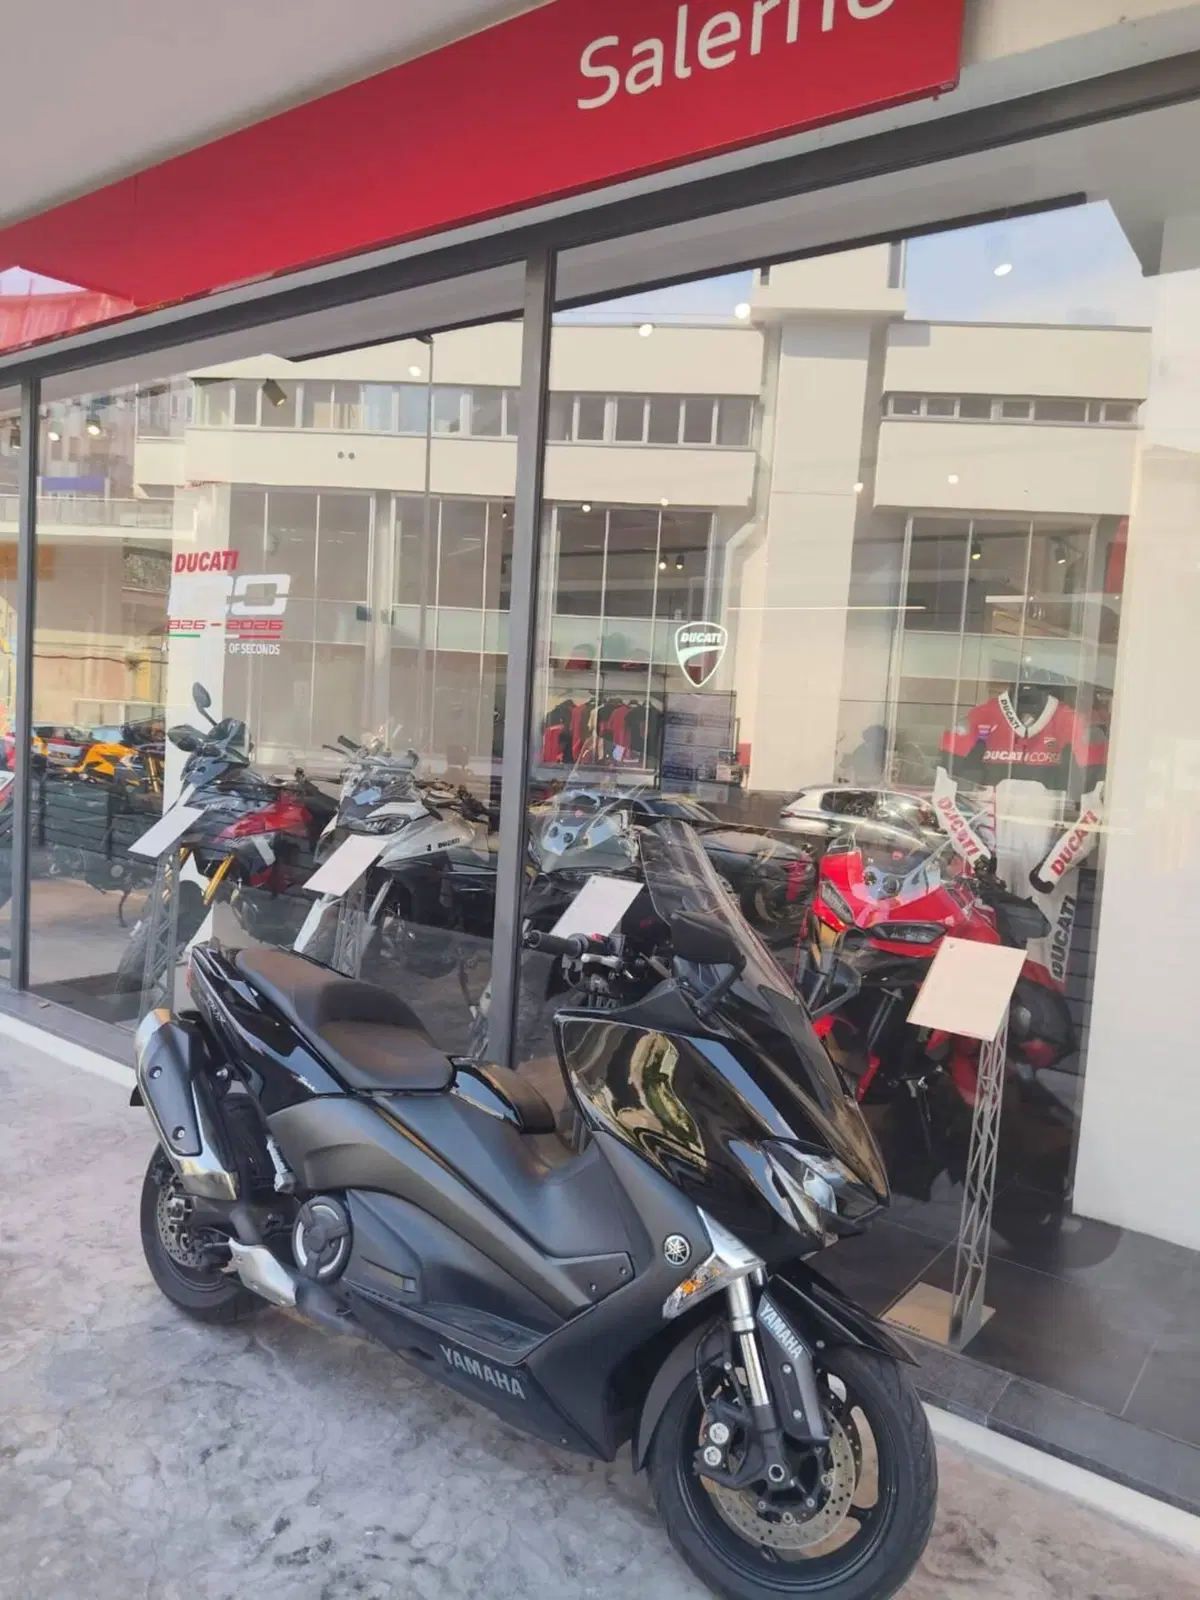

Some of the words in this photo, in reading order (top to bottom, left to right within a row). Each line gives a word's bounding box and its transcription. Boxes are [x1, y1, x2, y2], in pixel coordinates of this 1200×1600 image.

[174, 550, 240, 573] DUCATI
[225, 619, 284, 631] 2026
[679, 632, 722, 644] DUCATI
[228, 643, 240, 654] OF
[240, 643, 280, 656] SECONDS
[1000, 698, 1020, 730] DUCATI
[983, 750, 1029, 762] DUCATI
[1050, 810, 1099, 877] DUCATI
[1051, 894, 1077, 981] DUCATI
[760, 1302, 804, 1360] YAMAHA
[439, 1343, 526, 1401] YAMAHA
